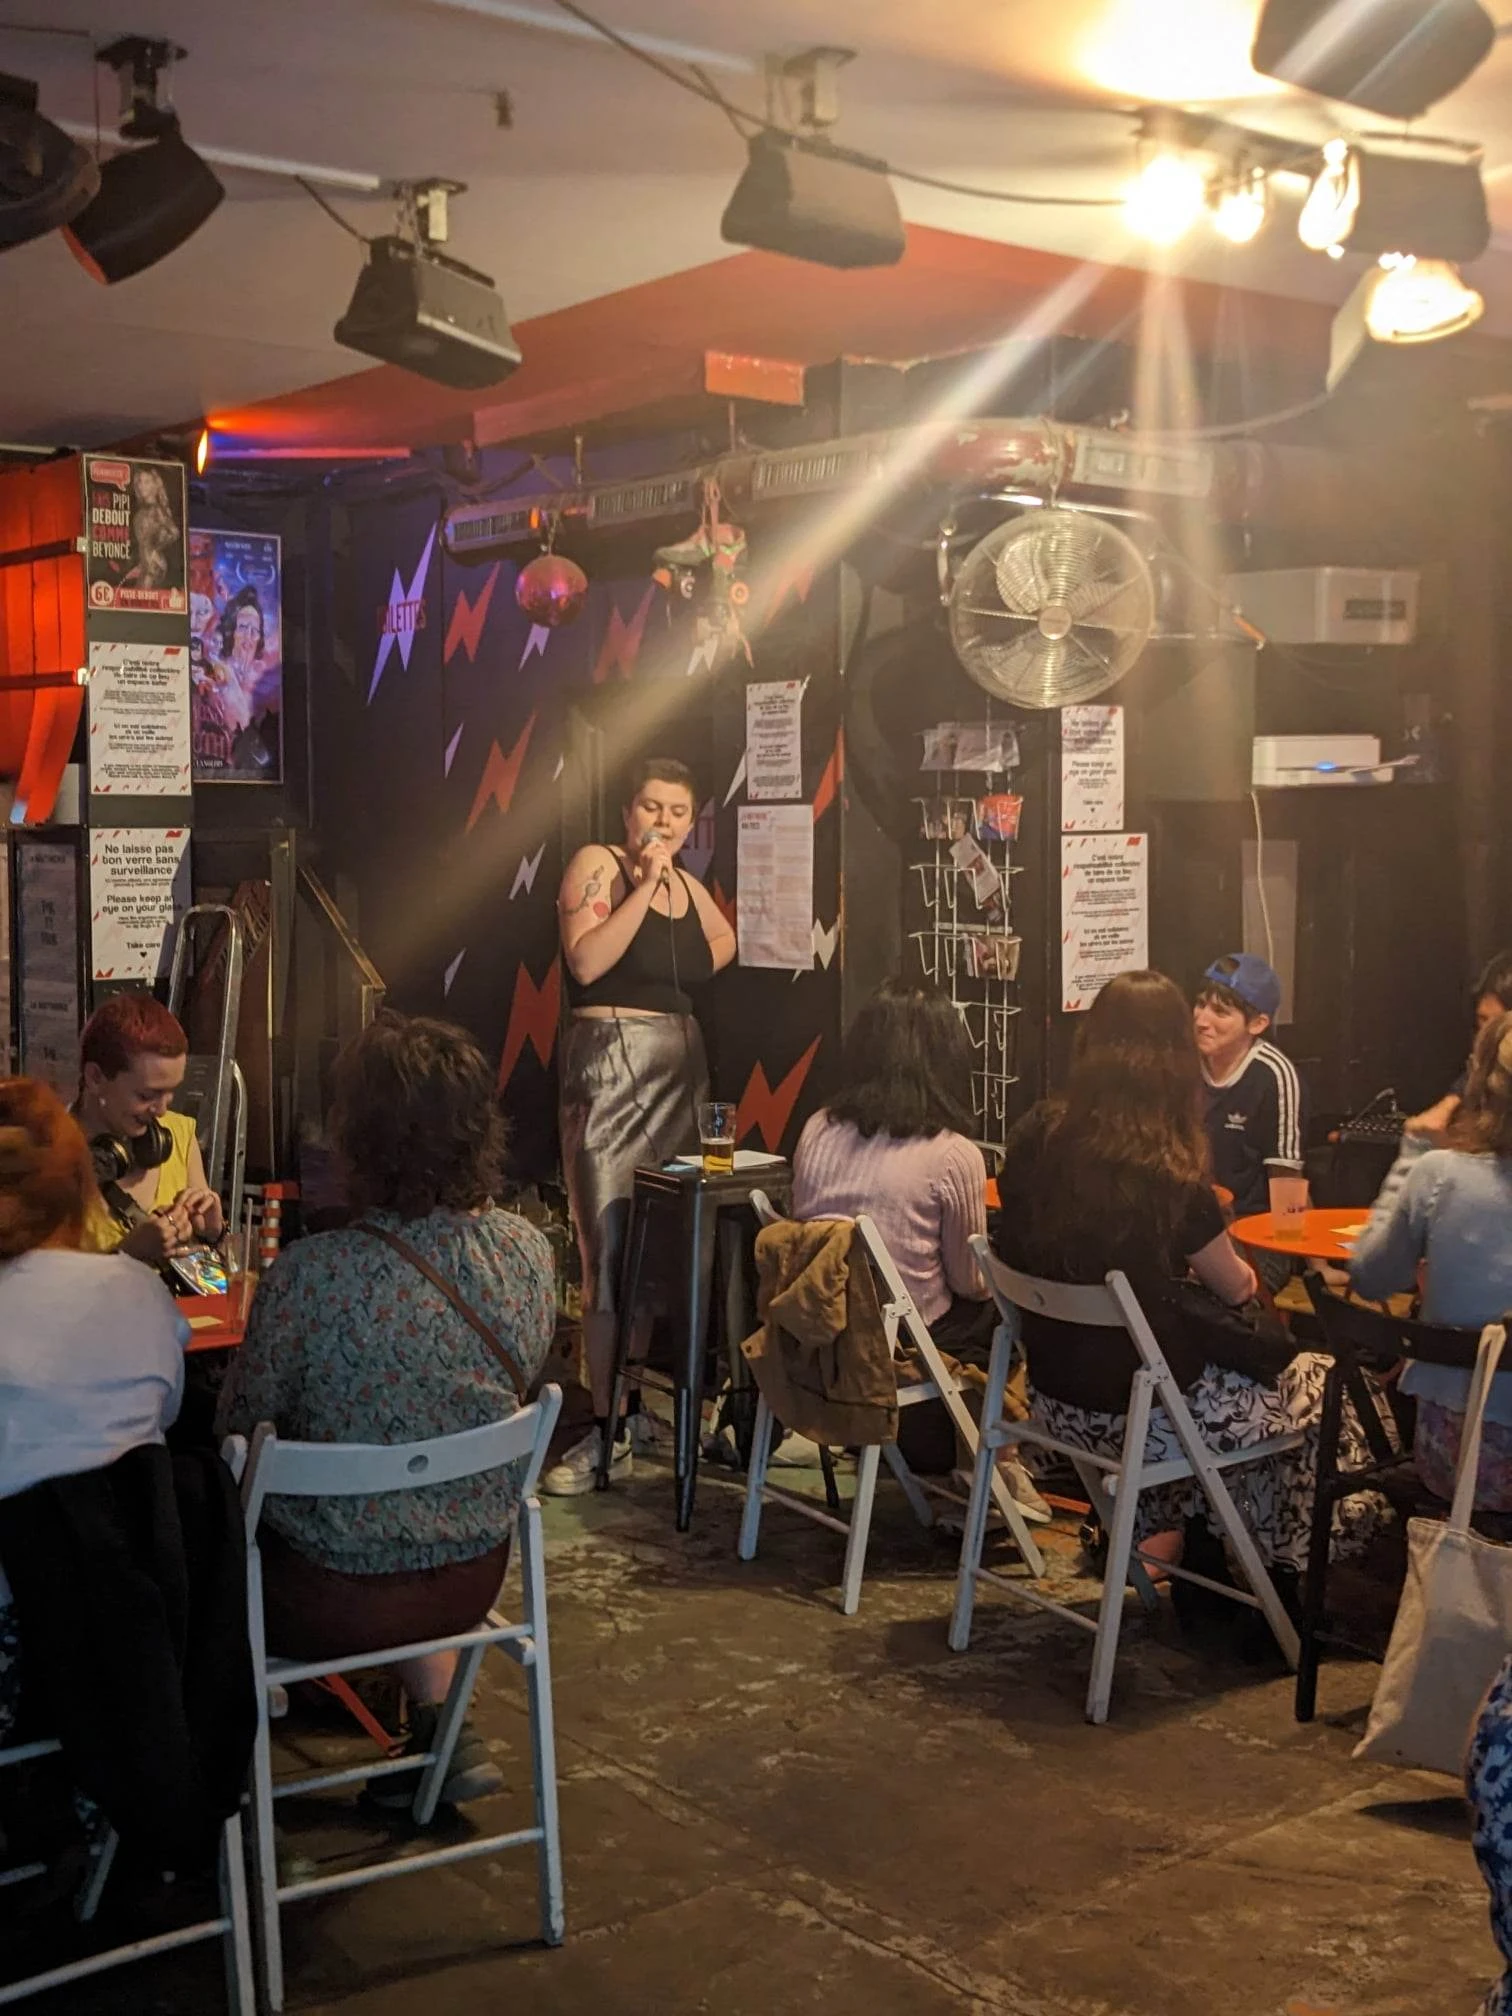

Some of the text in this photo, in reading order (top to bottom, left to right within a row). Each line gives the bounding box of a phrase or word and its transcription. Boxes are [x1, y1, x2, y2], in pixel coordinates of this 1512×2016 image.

[113, 493, 130, 509] PIPI
[92, 509, 131, 526] DEBOUT
[93, 539, 131, 560] BEYONCÉ
[105, 844, 174, 856] Ne laisse pas
[126, 856, 152, 864] verre
[156, 856, 181, 864] sans
[110, 864, 172, 875] surveillance
[107, 894, 137, 903] Please
[140, 893, 161, 904] keep
[102, 905, 119, 915] eye
[136, 904, 156, 913] your
